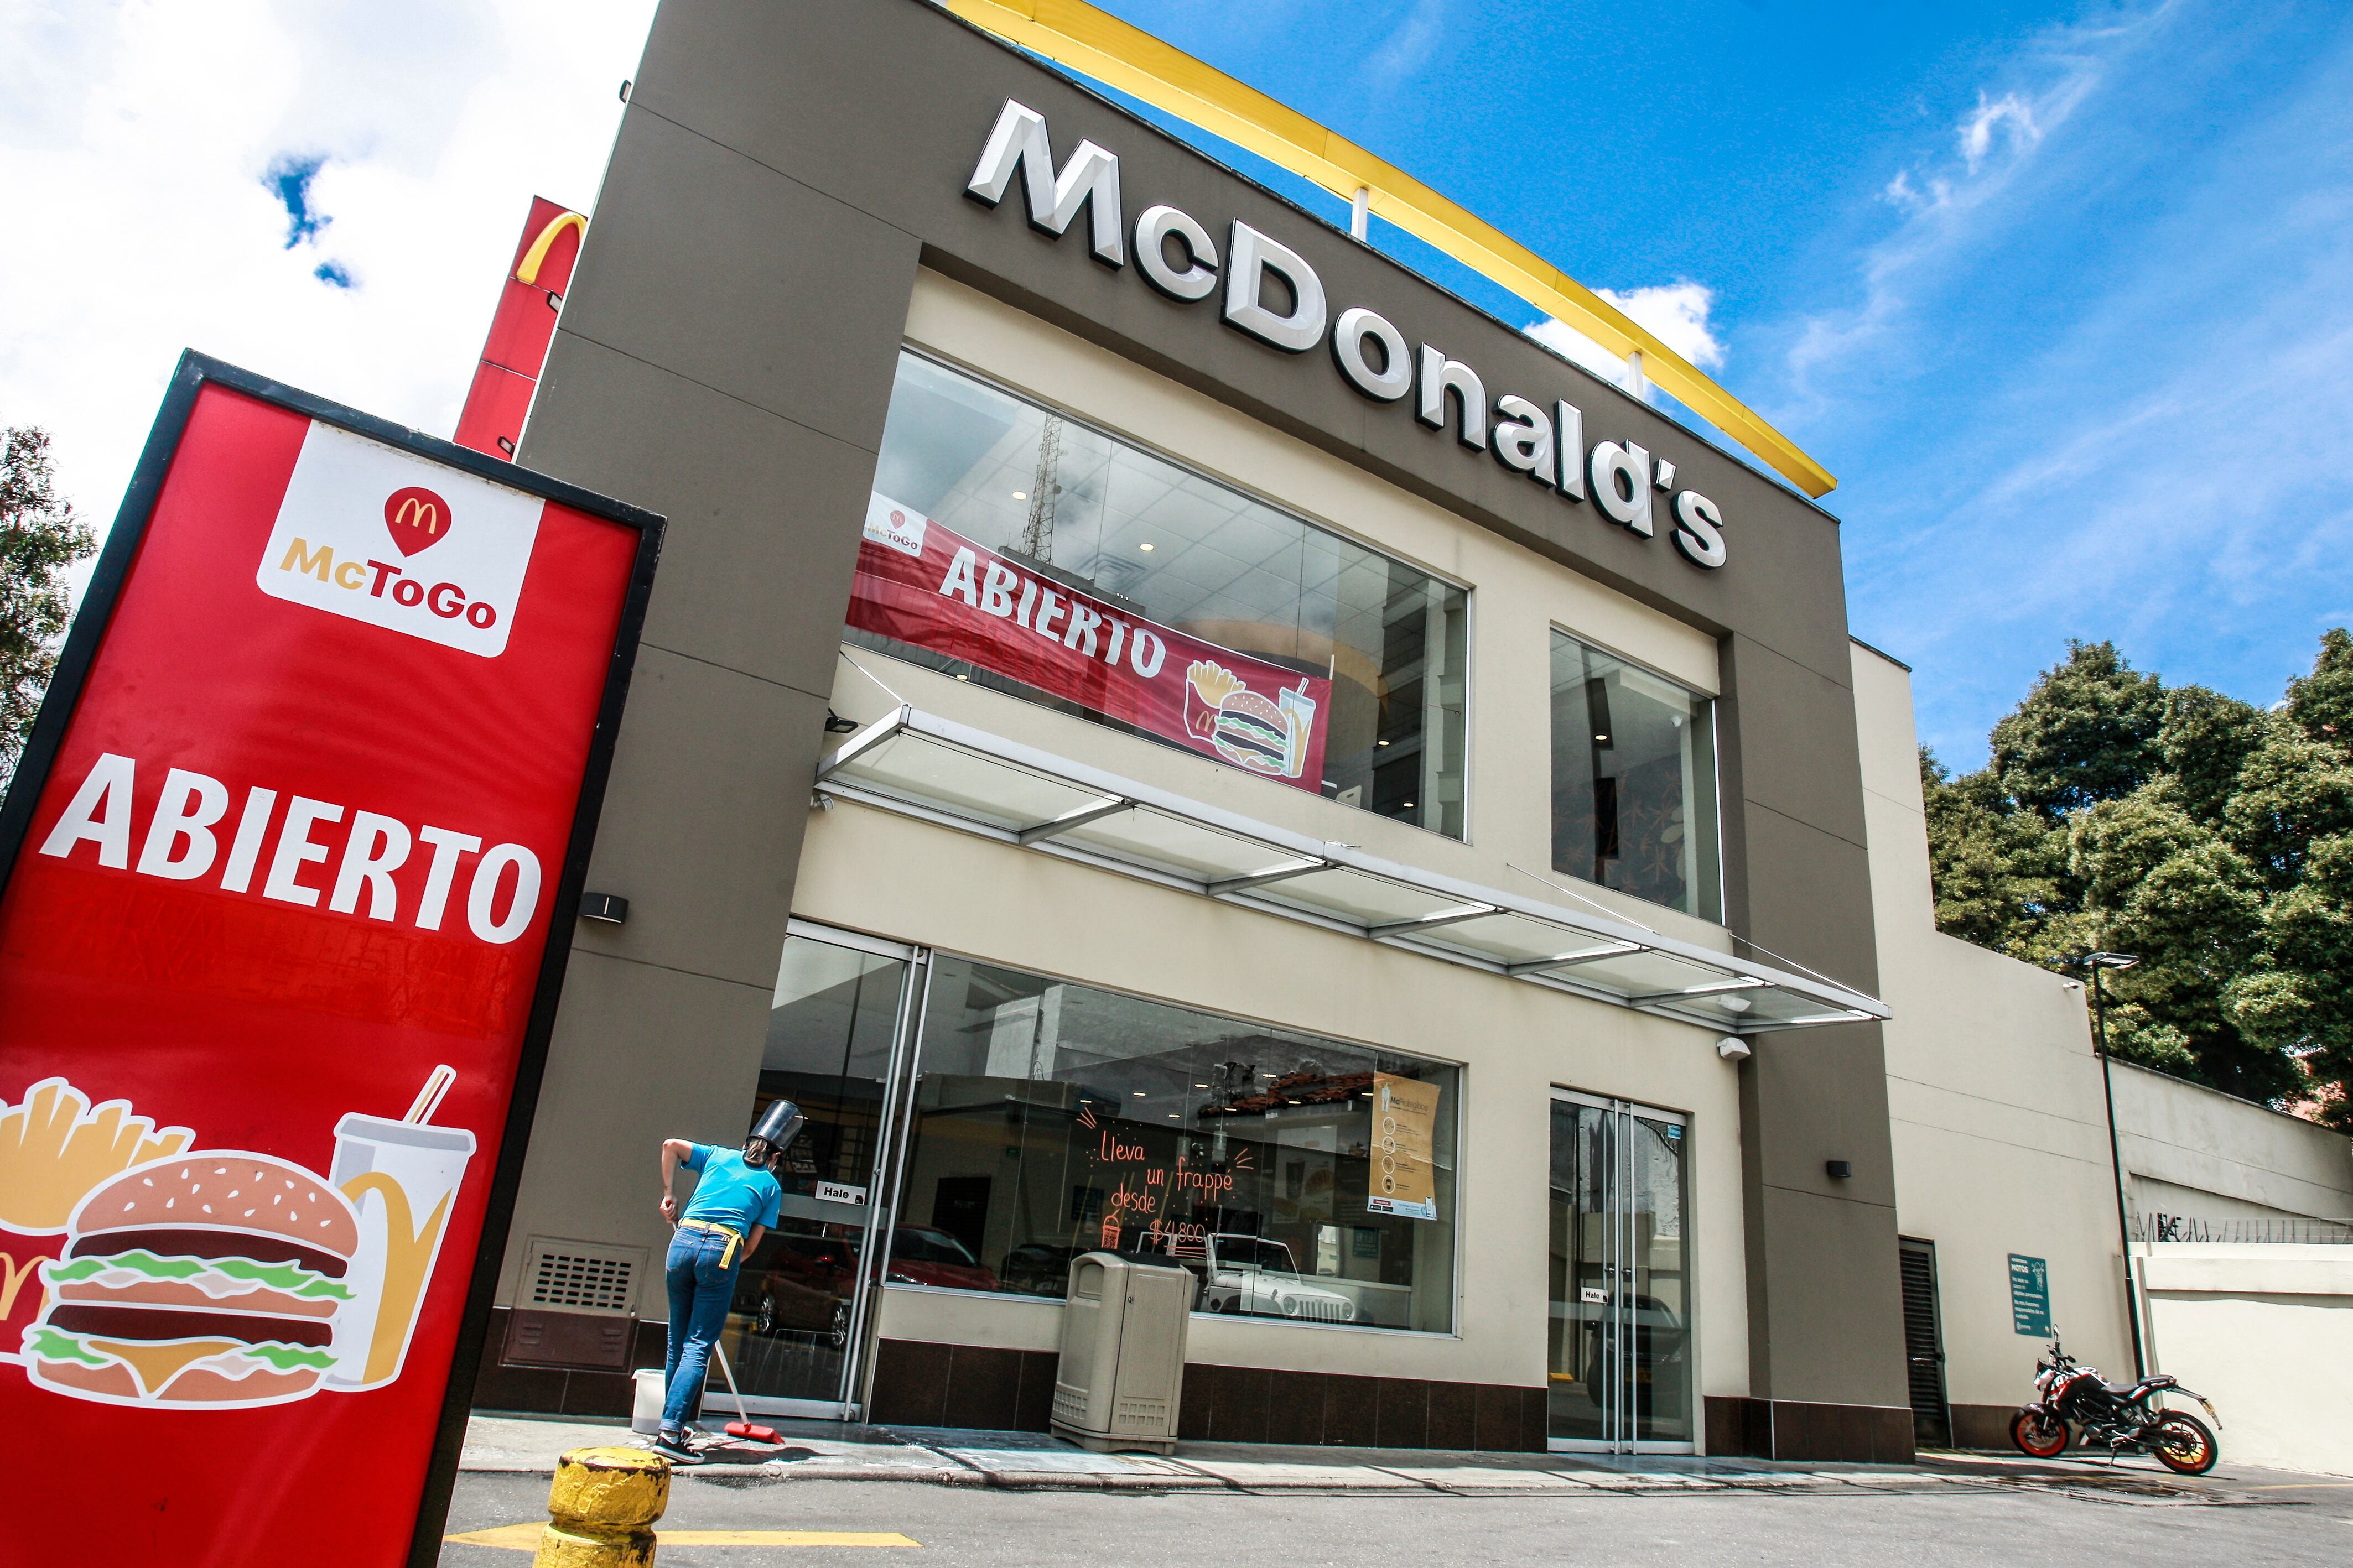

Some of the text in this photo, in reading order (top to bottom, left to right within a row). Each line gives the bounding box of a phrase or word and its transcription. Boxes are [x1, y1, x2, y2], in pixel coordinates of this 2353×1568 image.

[964, 96, 1727, 570] McDonald's
[867, 523, 918, 550] McToGo
[278, 536, 497, 630] McToGo
[938, 545, 1167, 679] ABIERTO
[38, 752, 542, 945] ABIERTO
[1101, 1130, 1145, 1162] Lleva
[823, 1187, 849, 1199] Hale
[1147, 1156, 1233, 1201] un frappé
[1111, 1182, 1156, 1213] desde
[2011, 1264, 2028, 1273] MOTOS
[1586, 1291, 1599, 1299] Hale
